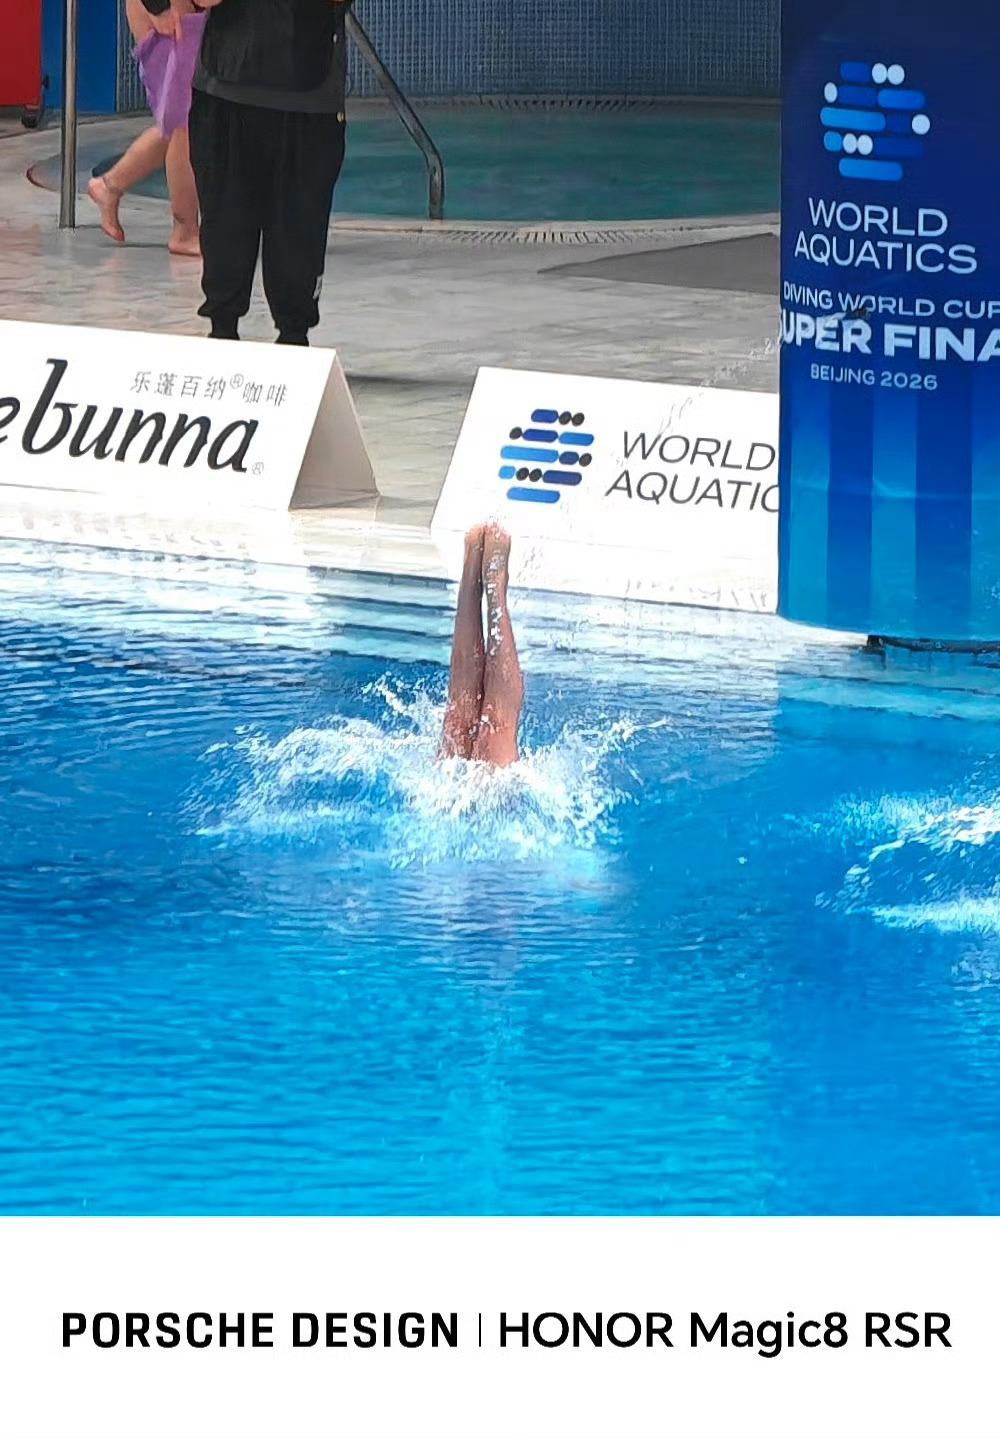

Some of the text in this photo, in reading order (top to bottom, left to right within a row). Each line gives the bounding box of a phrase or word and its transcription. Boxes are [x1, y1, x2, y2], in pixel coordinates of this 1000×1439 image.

[808, 197, 948, 237] WORLD
[795, 231, 977, 274] AQUATICS
[784, 281, 833, 309] DIVING
[838, 292, 935, 317] WORLD
[779, 308, 872, 354] UPER
[811, 363, 938, 390] BEIJING 2026
[623, 431, 776, 471] WORLD
